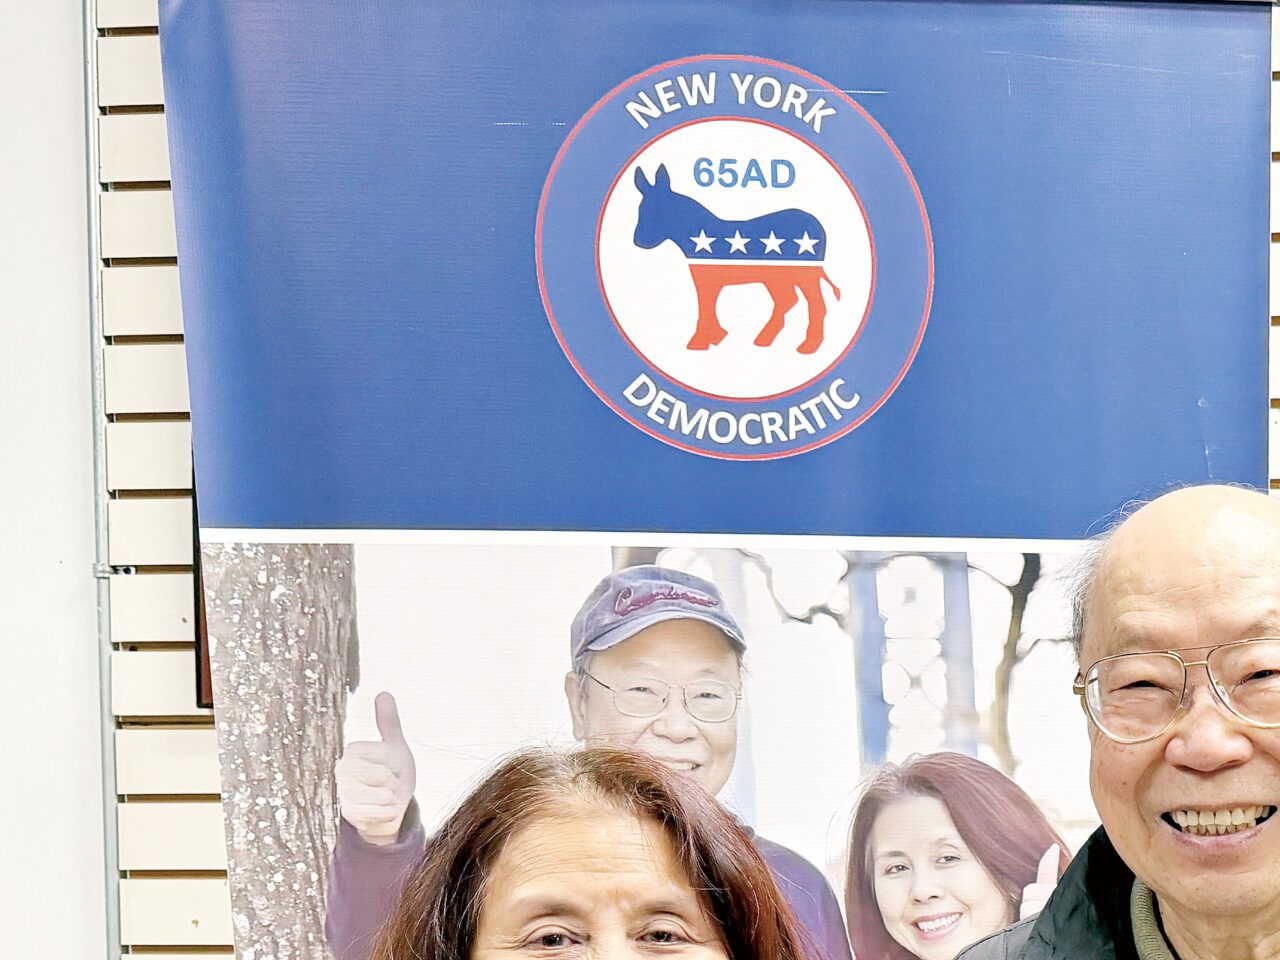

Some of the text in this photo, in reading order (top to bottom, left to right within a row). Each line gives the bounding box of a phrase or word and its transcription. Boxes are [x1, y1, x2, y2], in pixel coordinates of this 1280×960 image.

[625, 72, 837, 134] NEW YORK
[693, 157, 797, 189] 65AD
[622, 373, 861, 446] DEMOCRATIC
